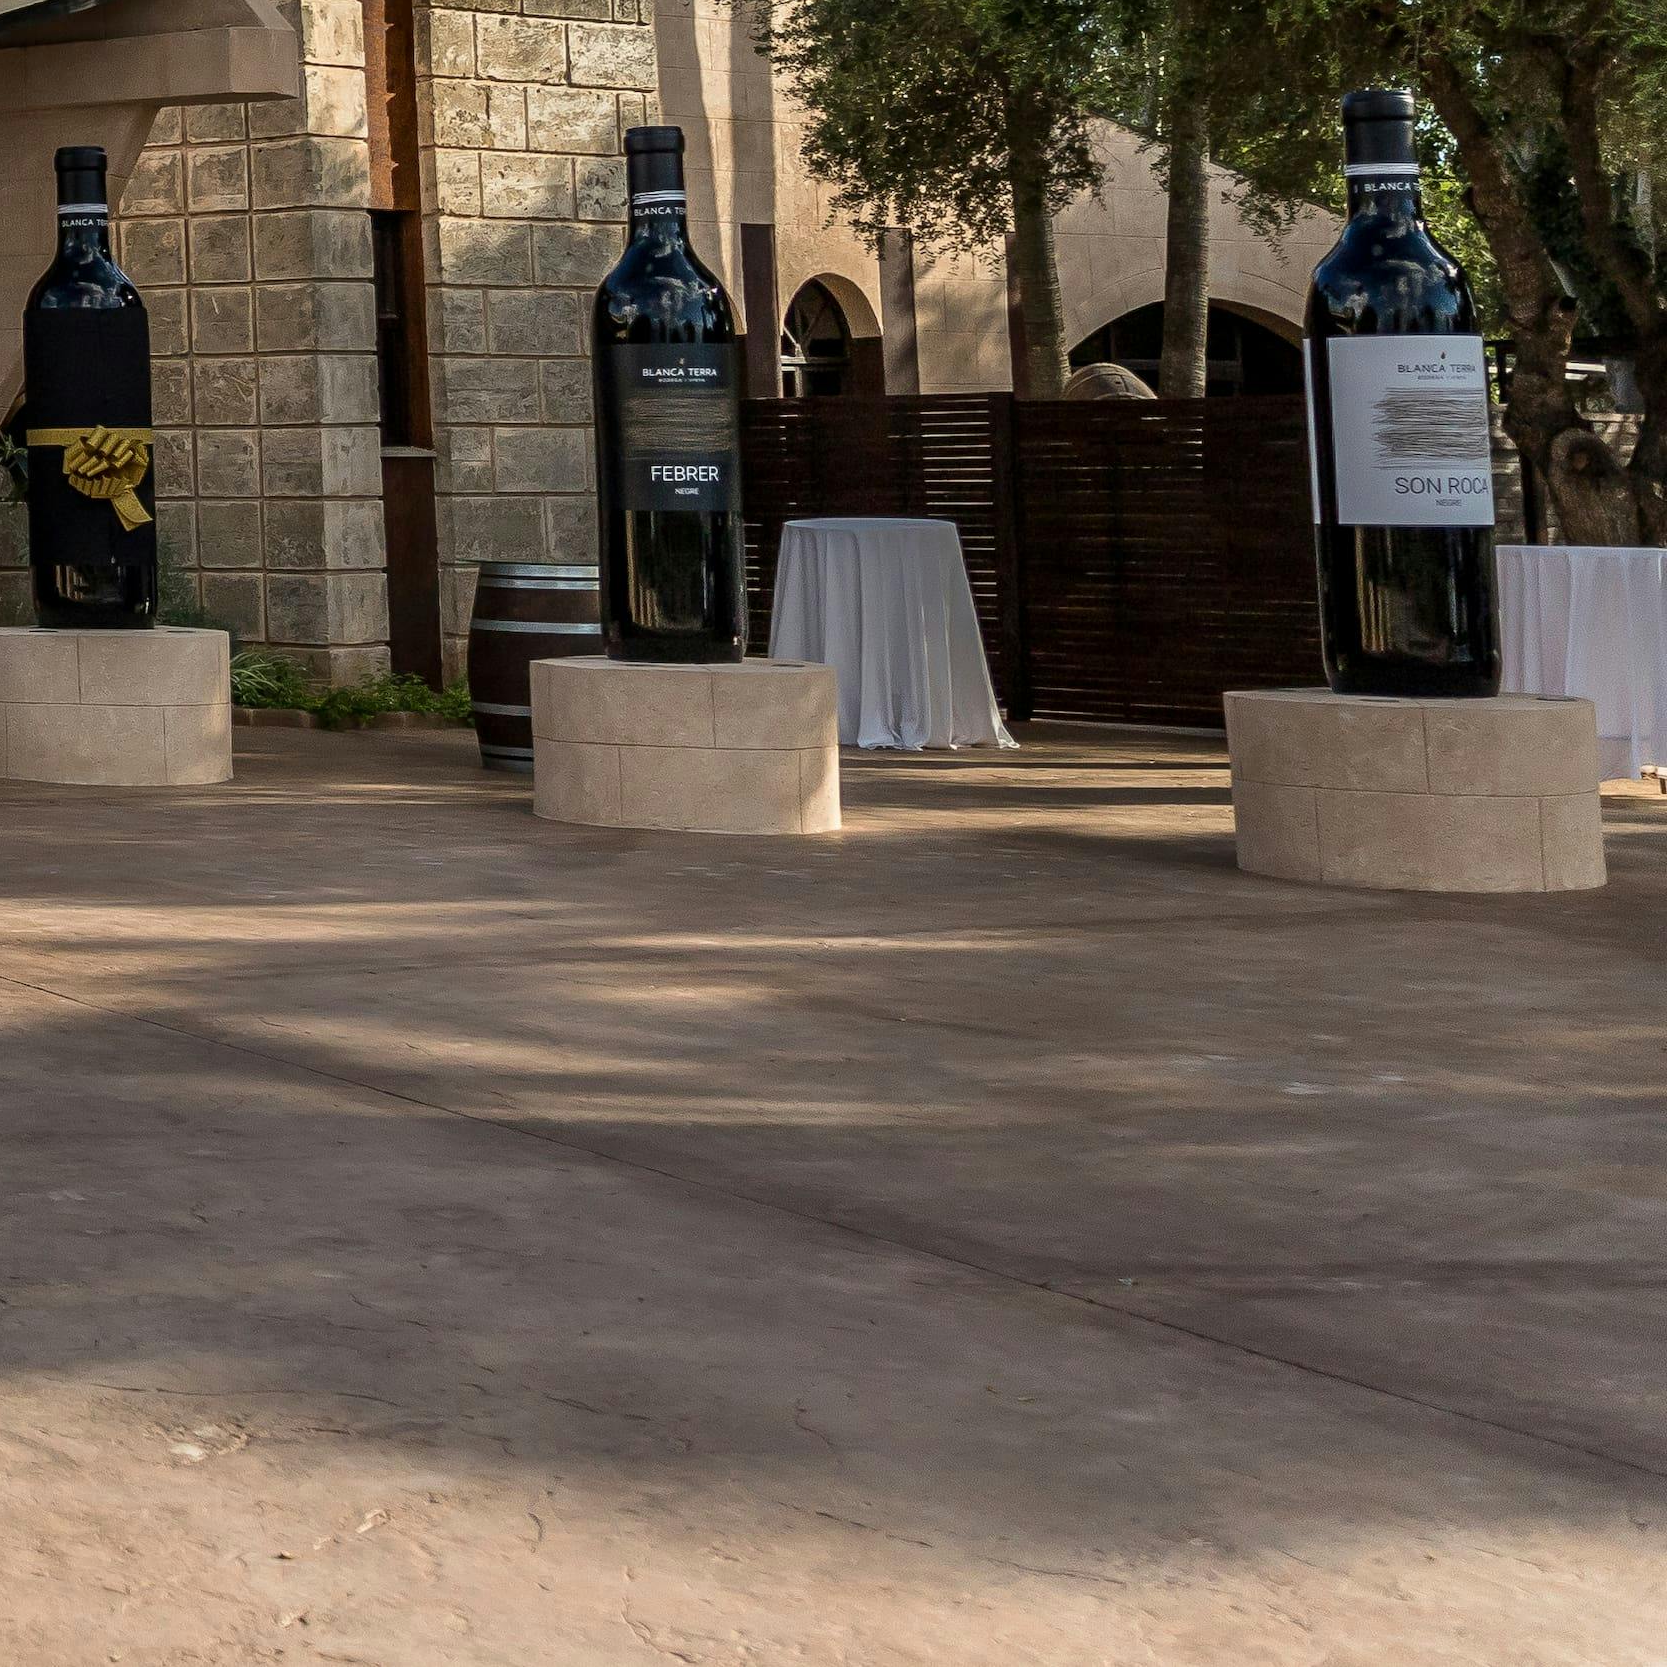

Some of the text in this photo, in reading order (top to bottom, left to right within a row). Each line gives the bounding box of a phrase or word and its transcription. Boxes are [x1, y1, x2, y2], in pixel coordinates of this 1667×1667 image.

[1364, 181, 1412, 193] BLANCA
[633, 206, 672, 217] BLANCA
[61, 219, 94, 228] BLANCA
[642, 368, 717, 377] BLANCA TERRA
[1397, 363, 1476, 373] BLANCA TERRA
[650, 465, 720, 482] FEBRER
[1394, 477, 1442, 494] SON
[674, 487, 700, 495] NEGRE
